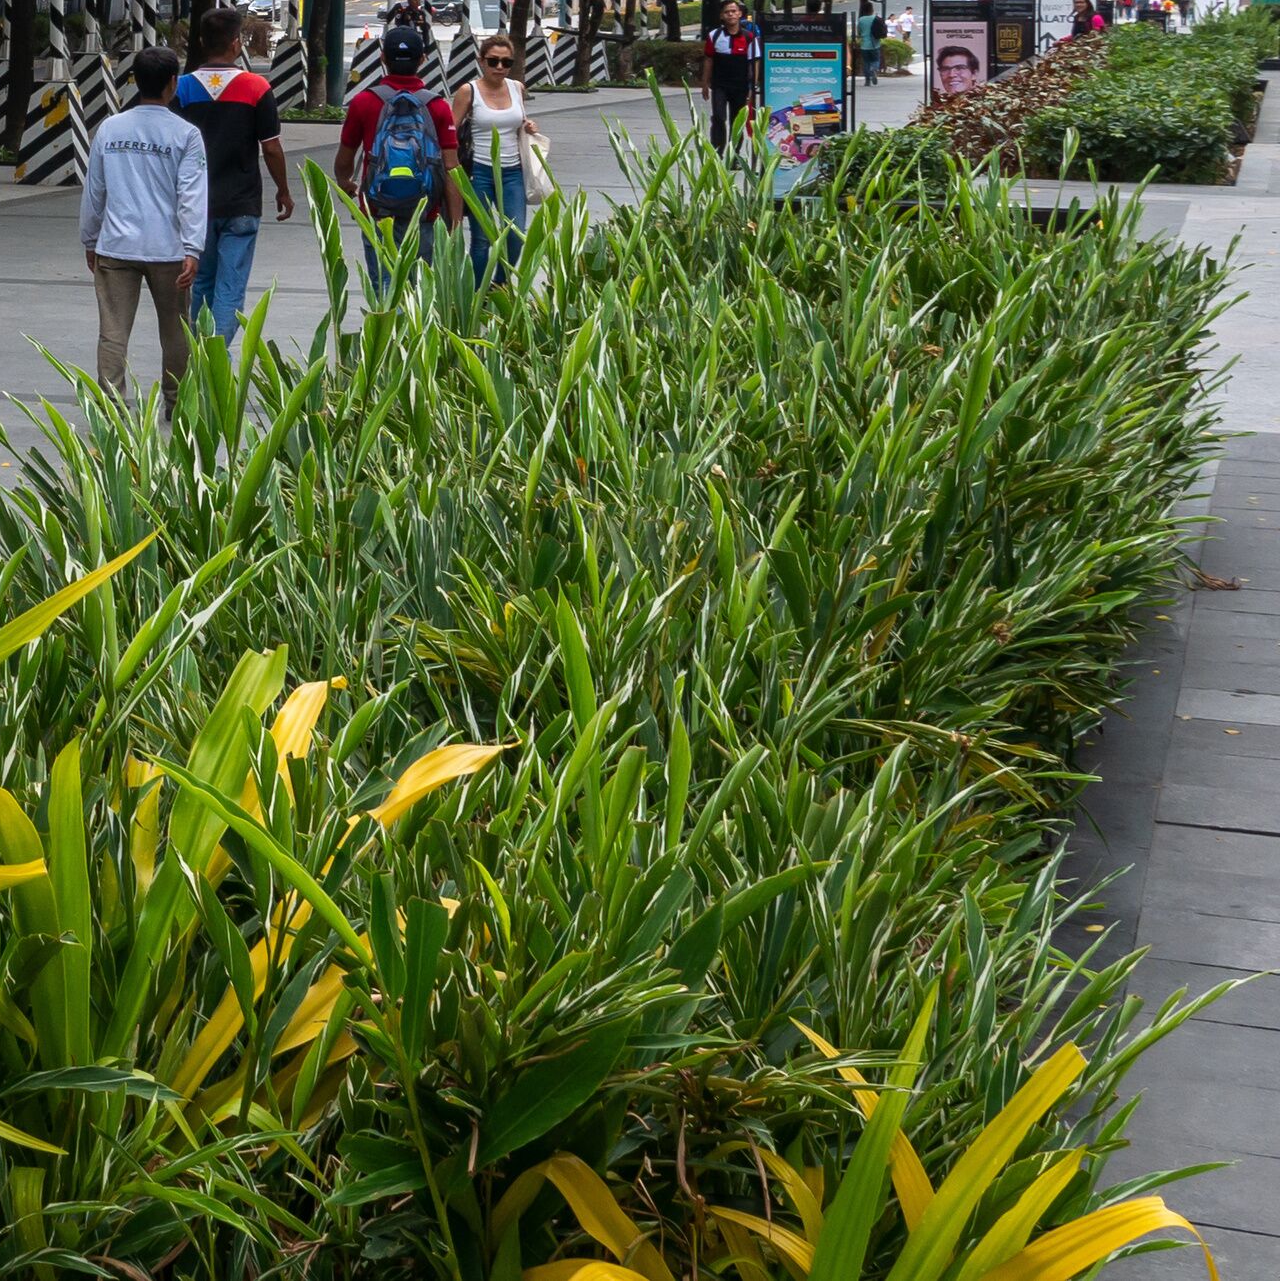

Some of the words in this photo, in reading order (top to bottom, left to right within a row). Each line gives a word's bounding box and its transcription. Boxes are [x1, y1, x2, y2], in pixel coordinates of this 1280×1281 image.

[773, 23, 810, 32] UPTOWN
[811, 24, 833, 32] MALL
[770, 66, 793, 74] YOUR
[793, 66, 811, 74] ONE
[812, 66, 833, 74] STOP
[769, 76, 799, 84] DIGITAL
[800, 77, 838, 85] PRINTING
[105, 140, 173, 154] INTERFIELD
